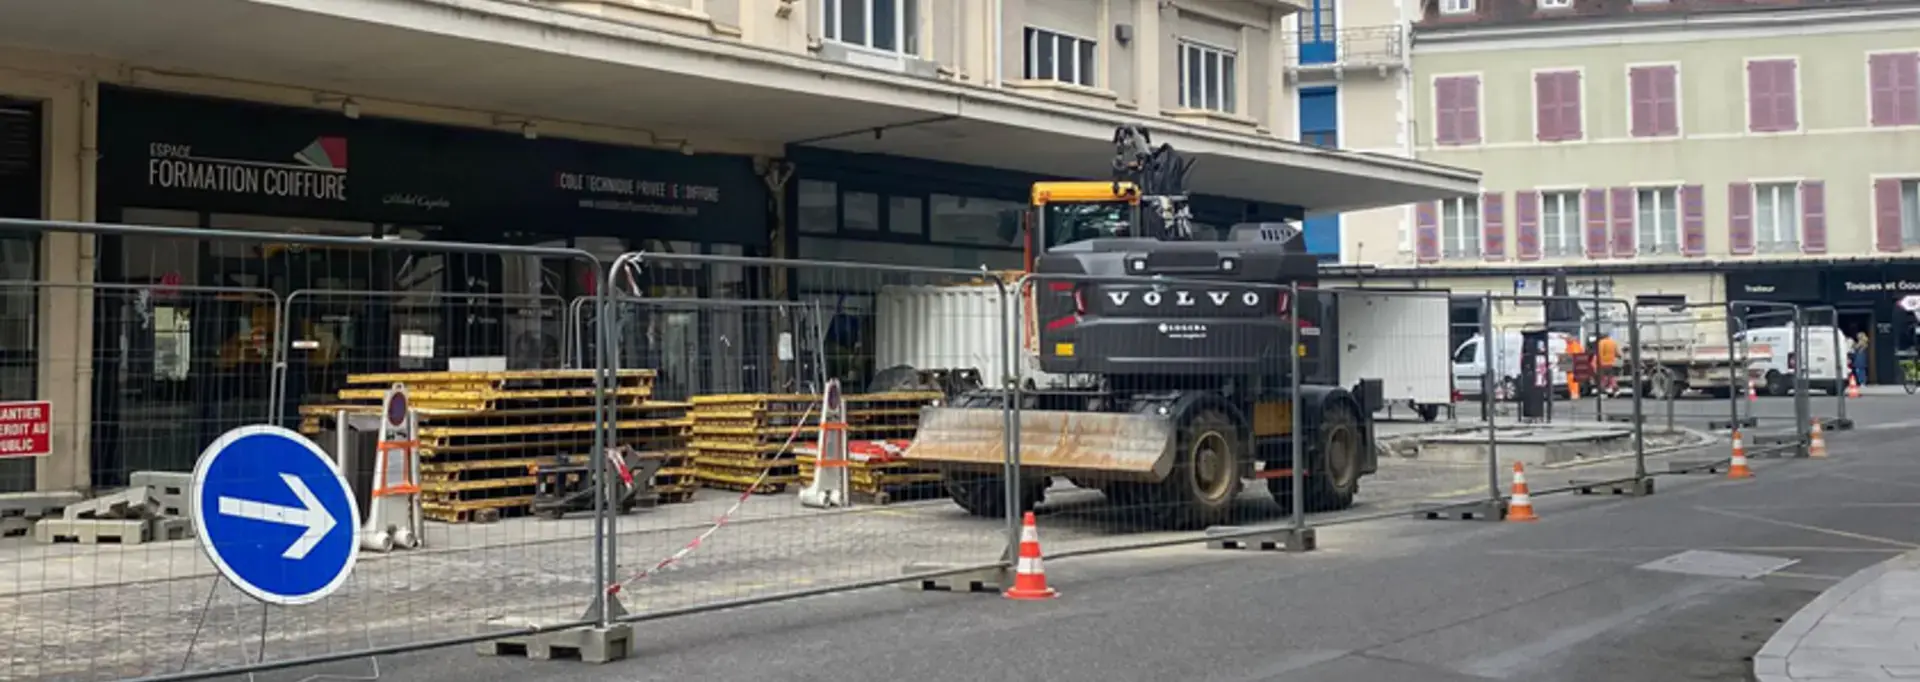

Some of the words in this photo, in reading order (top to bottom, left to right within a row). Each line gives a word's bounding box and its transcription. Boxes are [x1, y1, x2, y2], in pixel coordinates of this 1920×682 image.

[150, 142, 191, 158] ESPACE
[149, 159, 258, 193] FORMATION
[263, 168, 347, 200] COIFFURE
[586, 174, 634, 195] TECHNIQUE
[1744, 284, 1776, 293] Traiteur
[1844, 281, 1882, 291] Toques
[1885, 281, 1896, 290] et
[1898, 280, 1920, 290] Gou
[1108, 290, 1260, 306] VOLVO
[0, 407, 42, 420] ANTIER
[0, 422, 30, 436] ERDIT
[32, 422, 48, 434] AU
[0, 437, 34, 452] UBLIC
